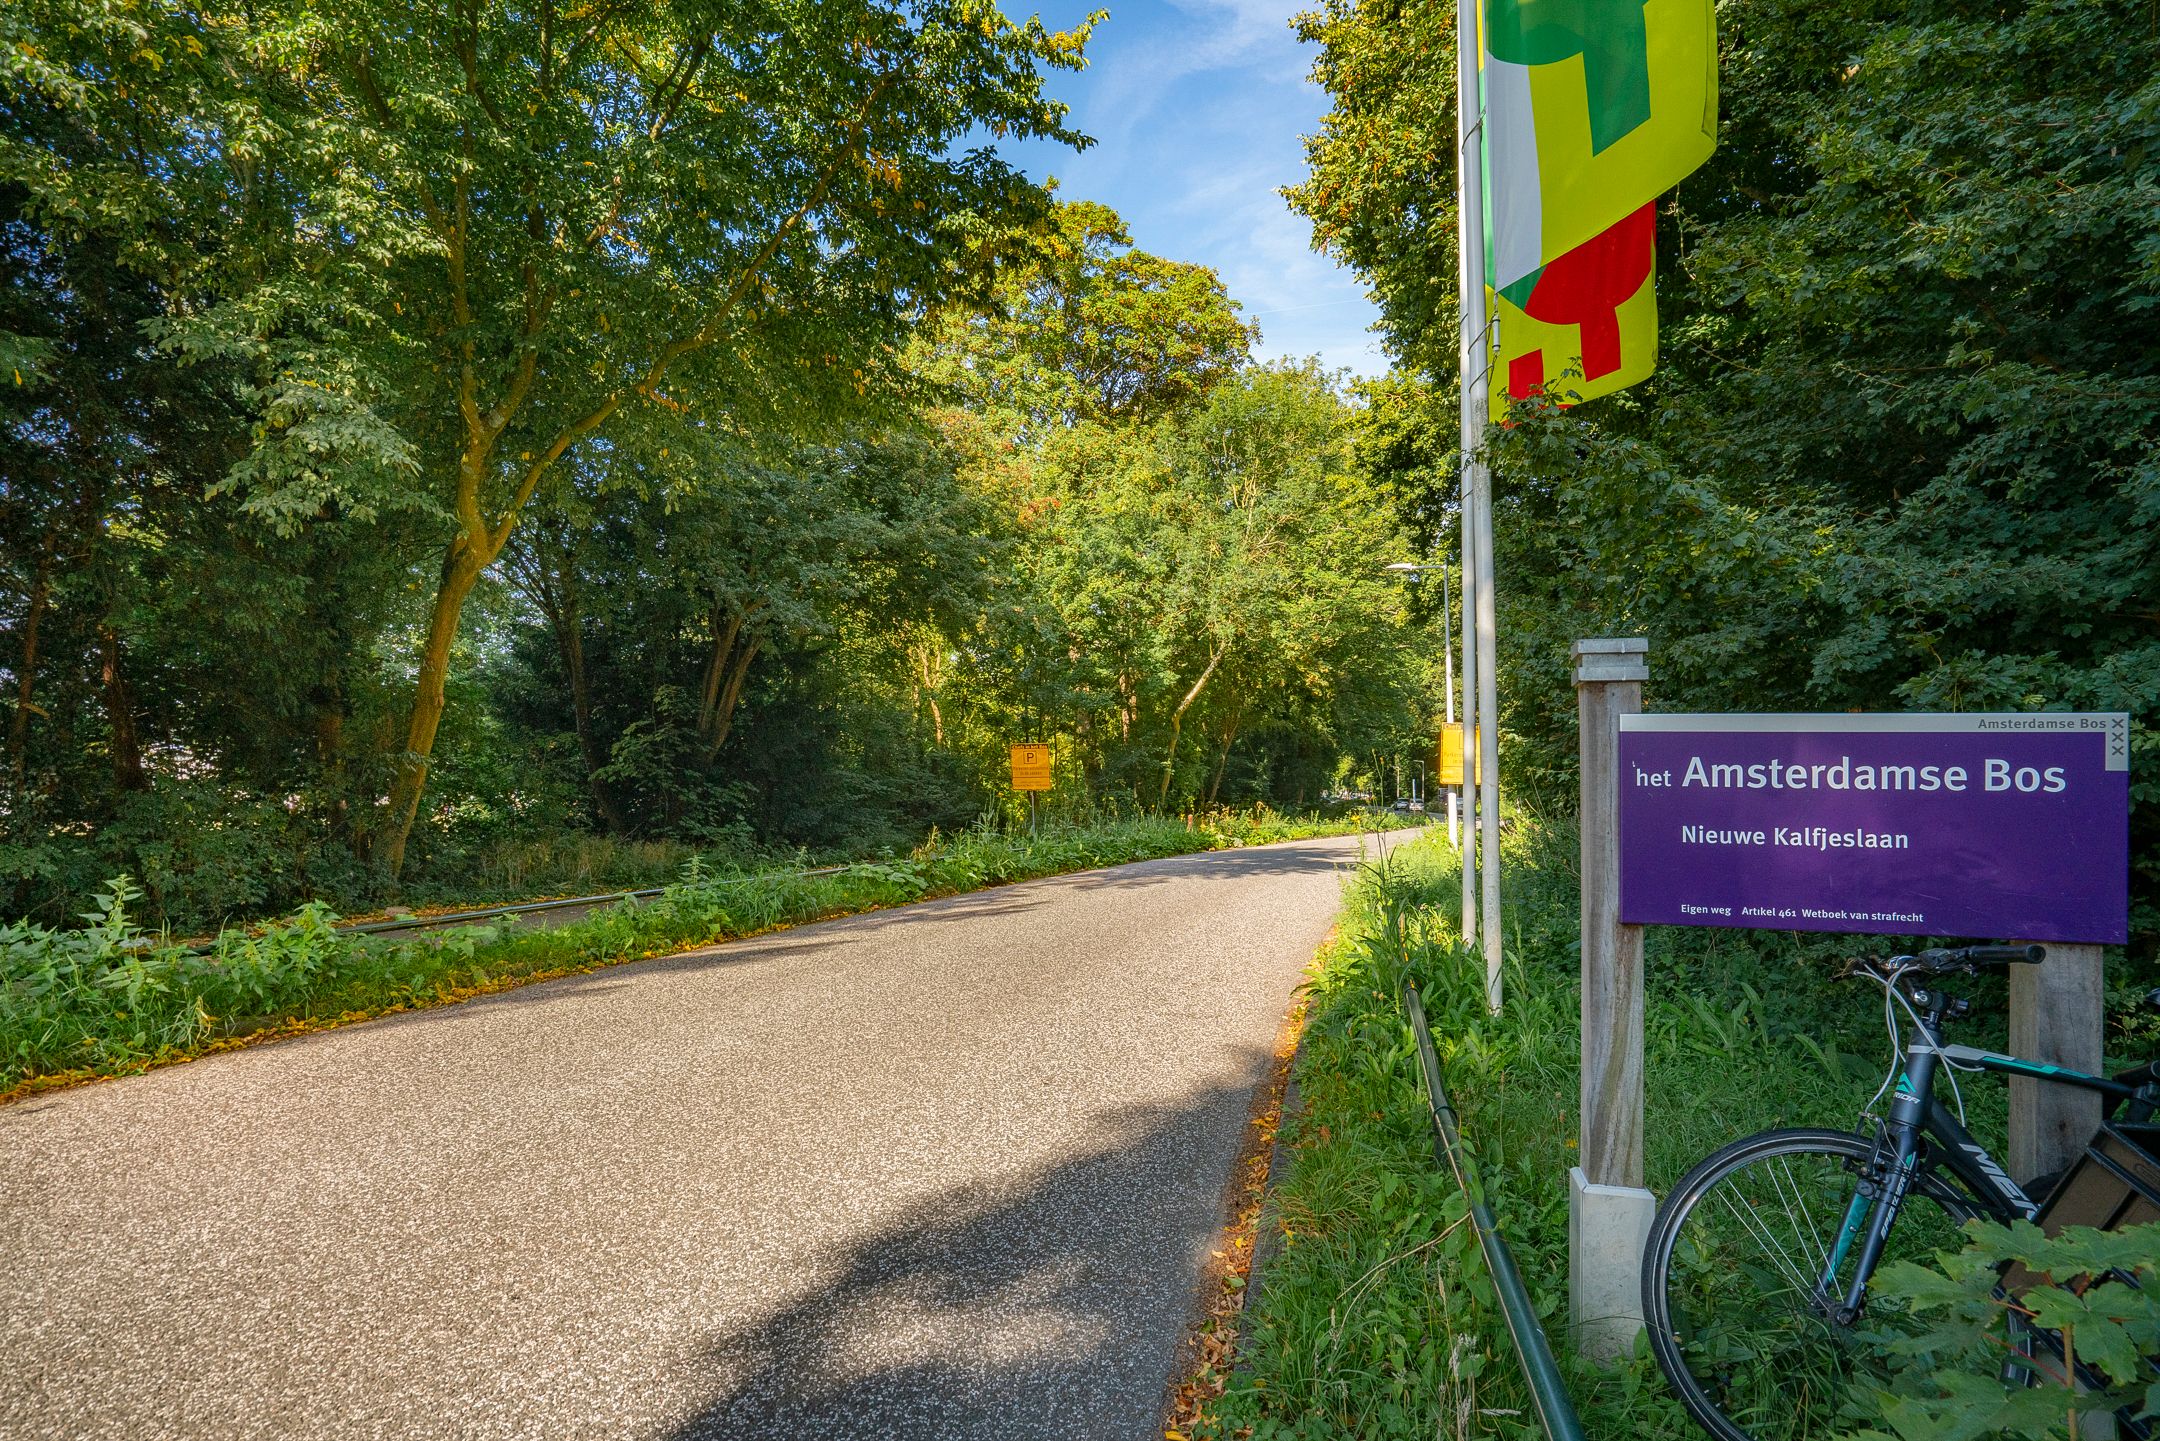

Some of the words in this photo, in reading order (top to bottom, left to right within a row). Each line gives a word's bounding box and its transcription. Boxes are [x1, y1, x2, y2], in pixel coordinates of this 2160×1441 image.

[1978, 718, 2075, 729] Amsterdamse
[2080, 718, 2106, 729] Bos
[1026, 752, 1034, 762] P
[1681, 755, 1968, 792] Amsterdamse
[1984, 758, 2066, 793] Bos
[1682, 825, 1766, 845] Nieuwe
[1774, 827, 1908, 852] Kalfjeslaan
[1681, 904, 1708, 915] Eigen
[1710, 907, 1732, 916] weg
[1741, 906, 1776, 917] Artikel
[1778, 908, 1797, 919] 461
[1801, 908, 1848, 919] Wetboek
[1849, 912, 1869, 920] van
[1871, 911, 1924, 922] strafrecht
